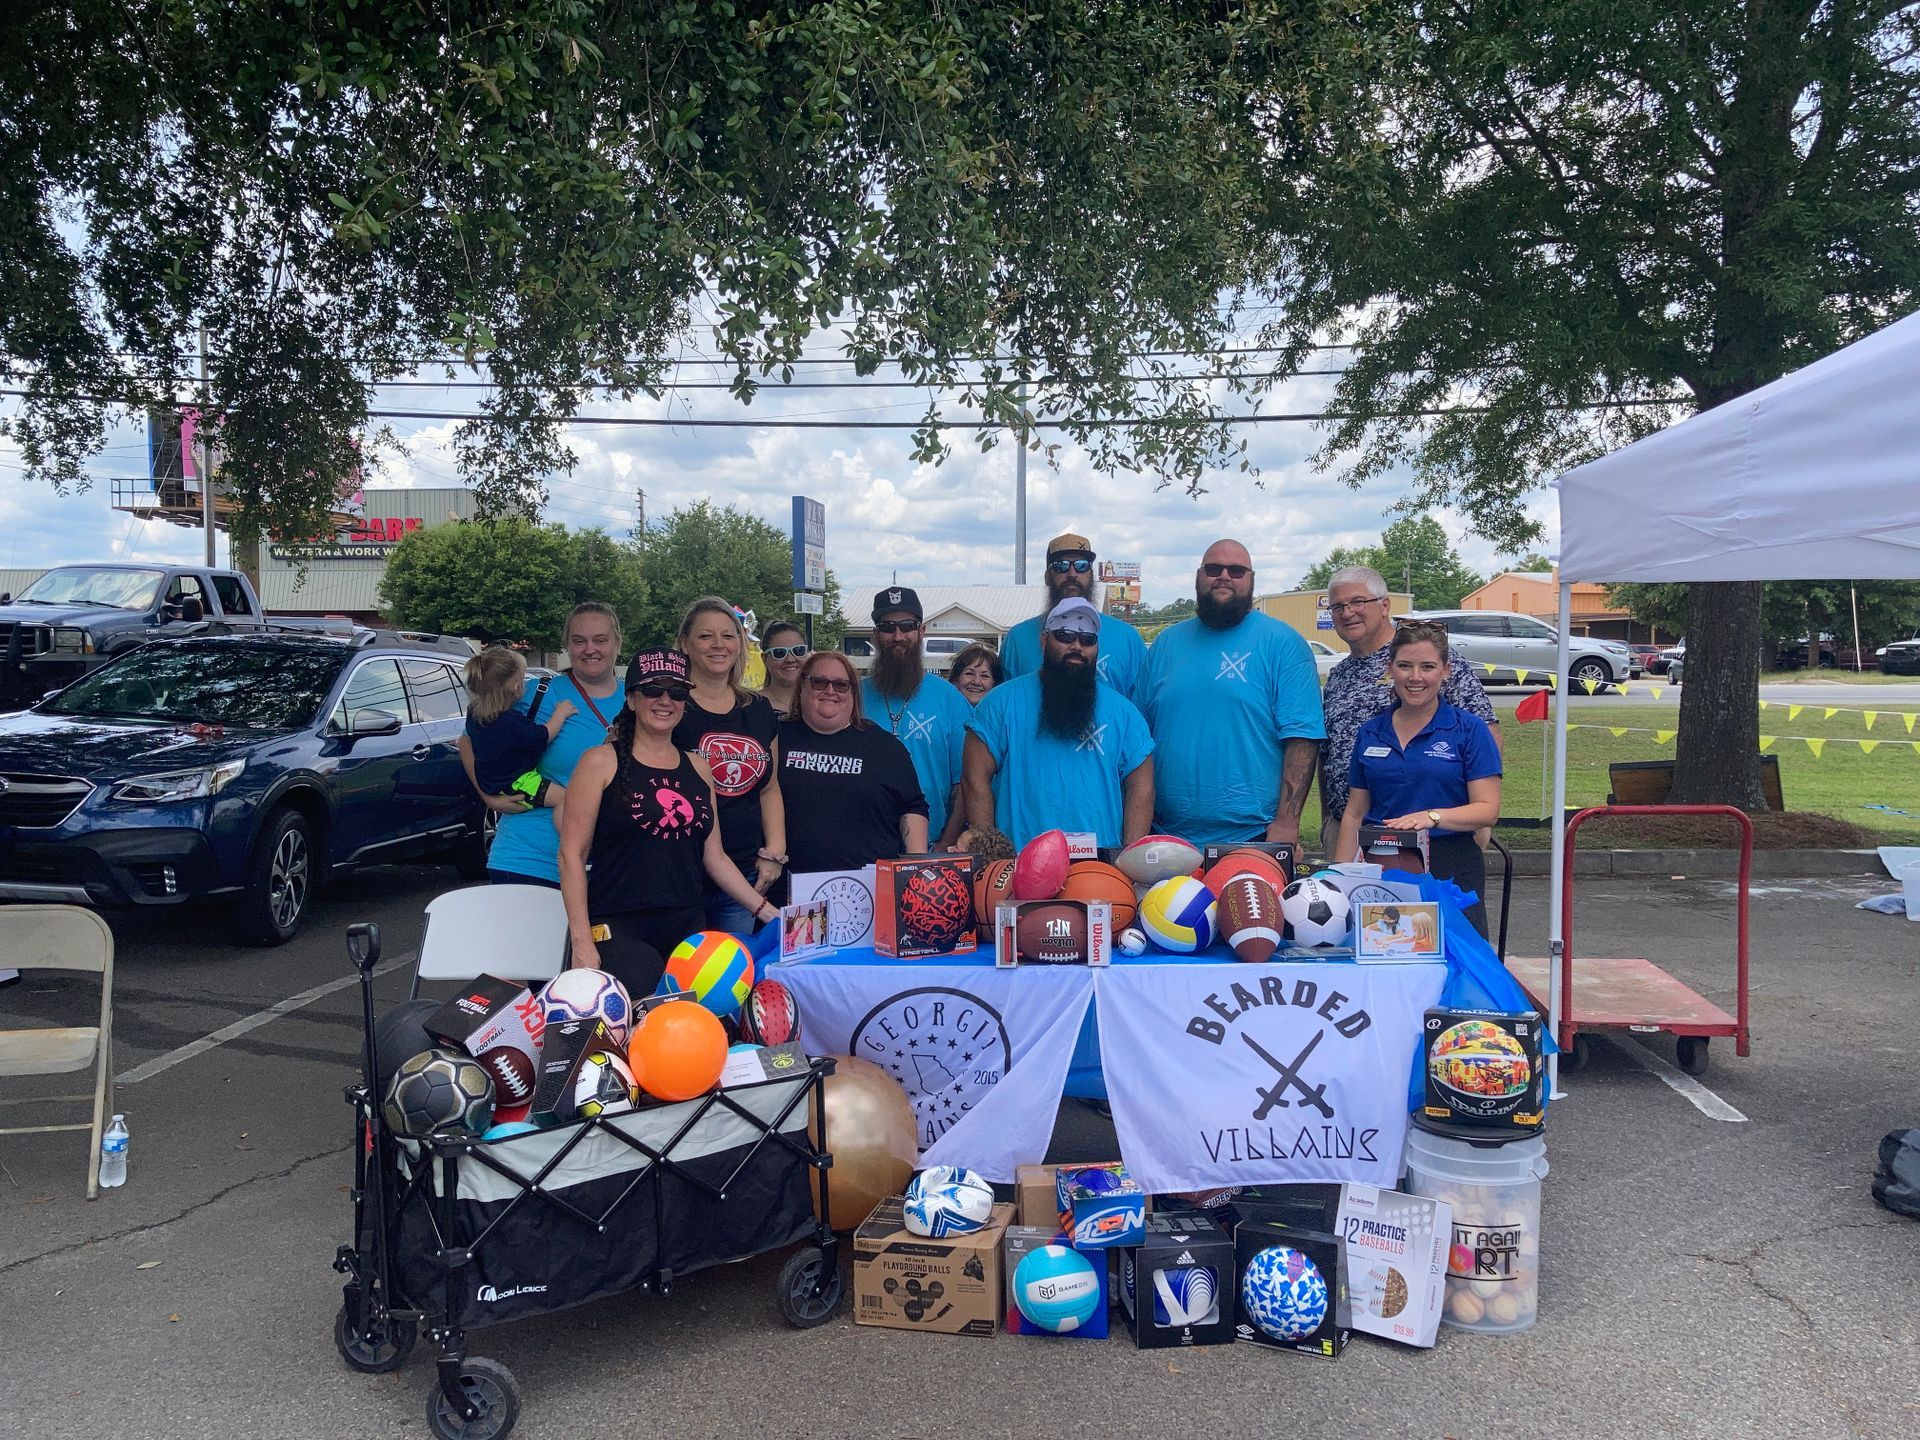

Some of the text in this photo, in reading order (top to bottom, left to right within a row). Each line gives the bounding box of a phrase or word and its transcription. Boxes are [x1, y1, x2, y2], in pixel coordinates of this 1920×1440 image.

[333, 548, 343, 556] &
[343, 548, 381, 556] WORK
[639, 651, 665, 662] Black
[640, 660, 686, 676] Villains
[785, 758, 862, 775] FORWARD
[787, 750, 863, 768] KEEP MOVING
[649, 777, 681, 788] THE
[1068, 844, 1094, 854] ilson
[1373, 839, 1403, 847] FOOTBALL
[816, 881, 868, 902] EORGIA
[1046, 919, 1071, 937] NFL
[1041, 937, 1076, 948] Wilson
[1092, 922, 1103, 962] Wilson
[455, 998, 490, 1015] FOOTBALL
[1186, 976, 1371, 1045] BEARDED
[475, 1027, 506, 1054] FOOTBALL
[973, 1070, 999, 1085] 2015
[1200, 1126, 1379, 1163] VILLAINS
[1343, 1216, 1407, 1244] 12 PRACTICE
[1456, 1229, 1472, 1245] IT
[1359, 1234, 1404, 1255] BASEBALLS
[883, 1261, 951, 1274] PLAYGROUND BALLS
[1430, 1264, 1440, 1275] 12
[1184, 1327, 1190, 1336] 5
[1393, 1324, 1415, 1338] $19.99
[1322, 1340, 1333, 1356] 5
